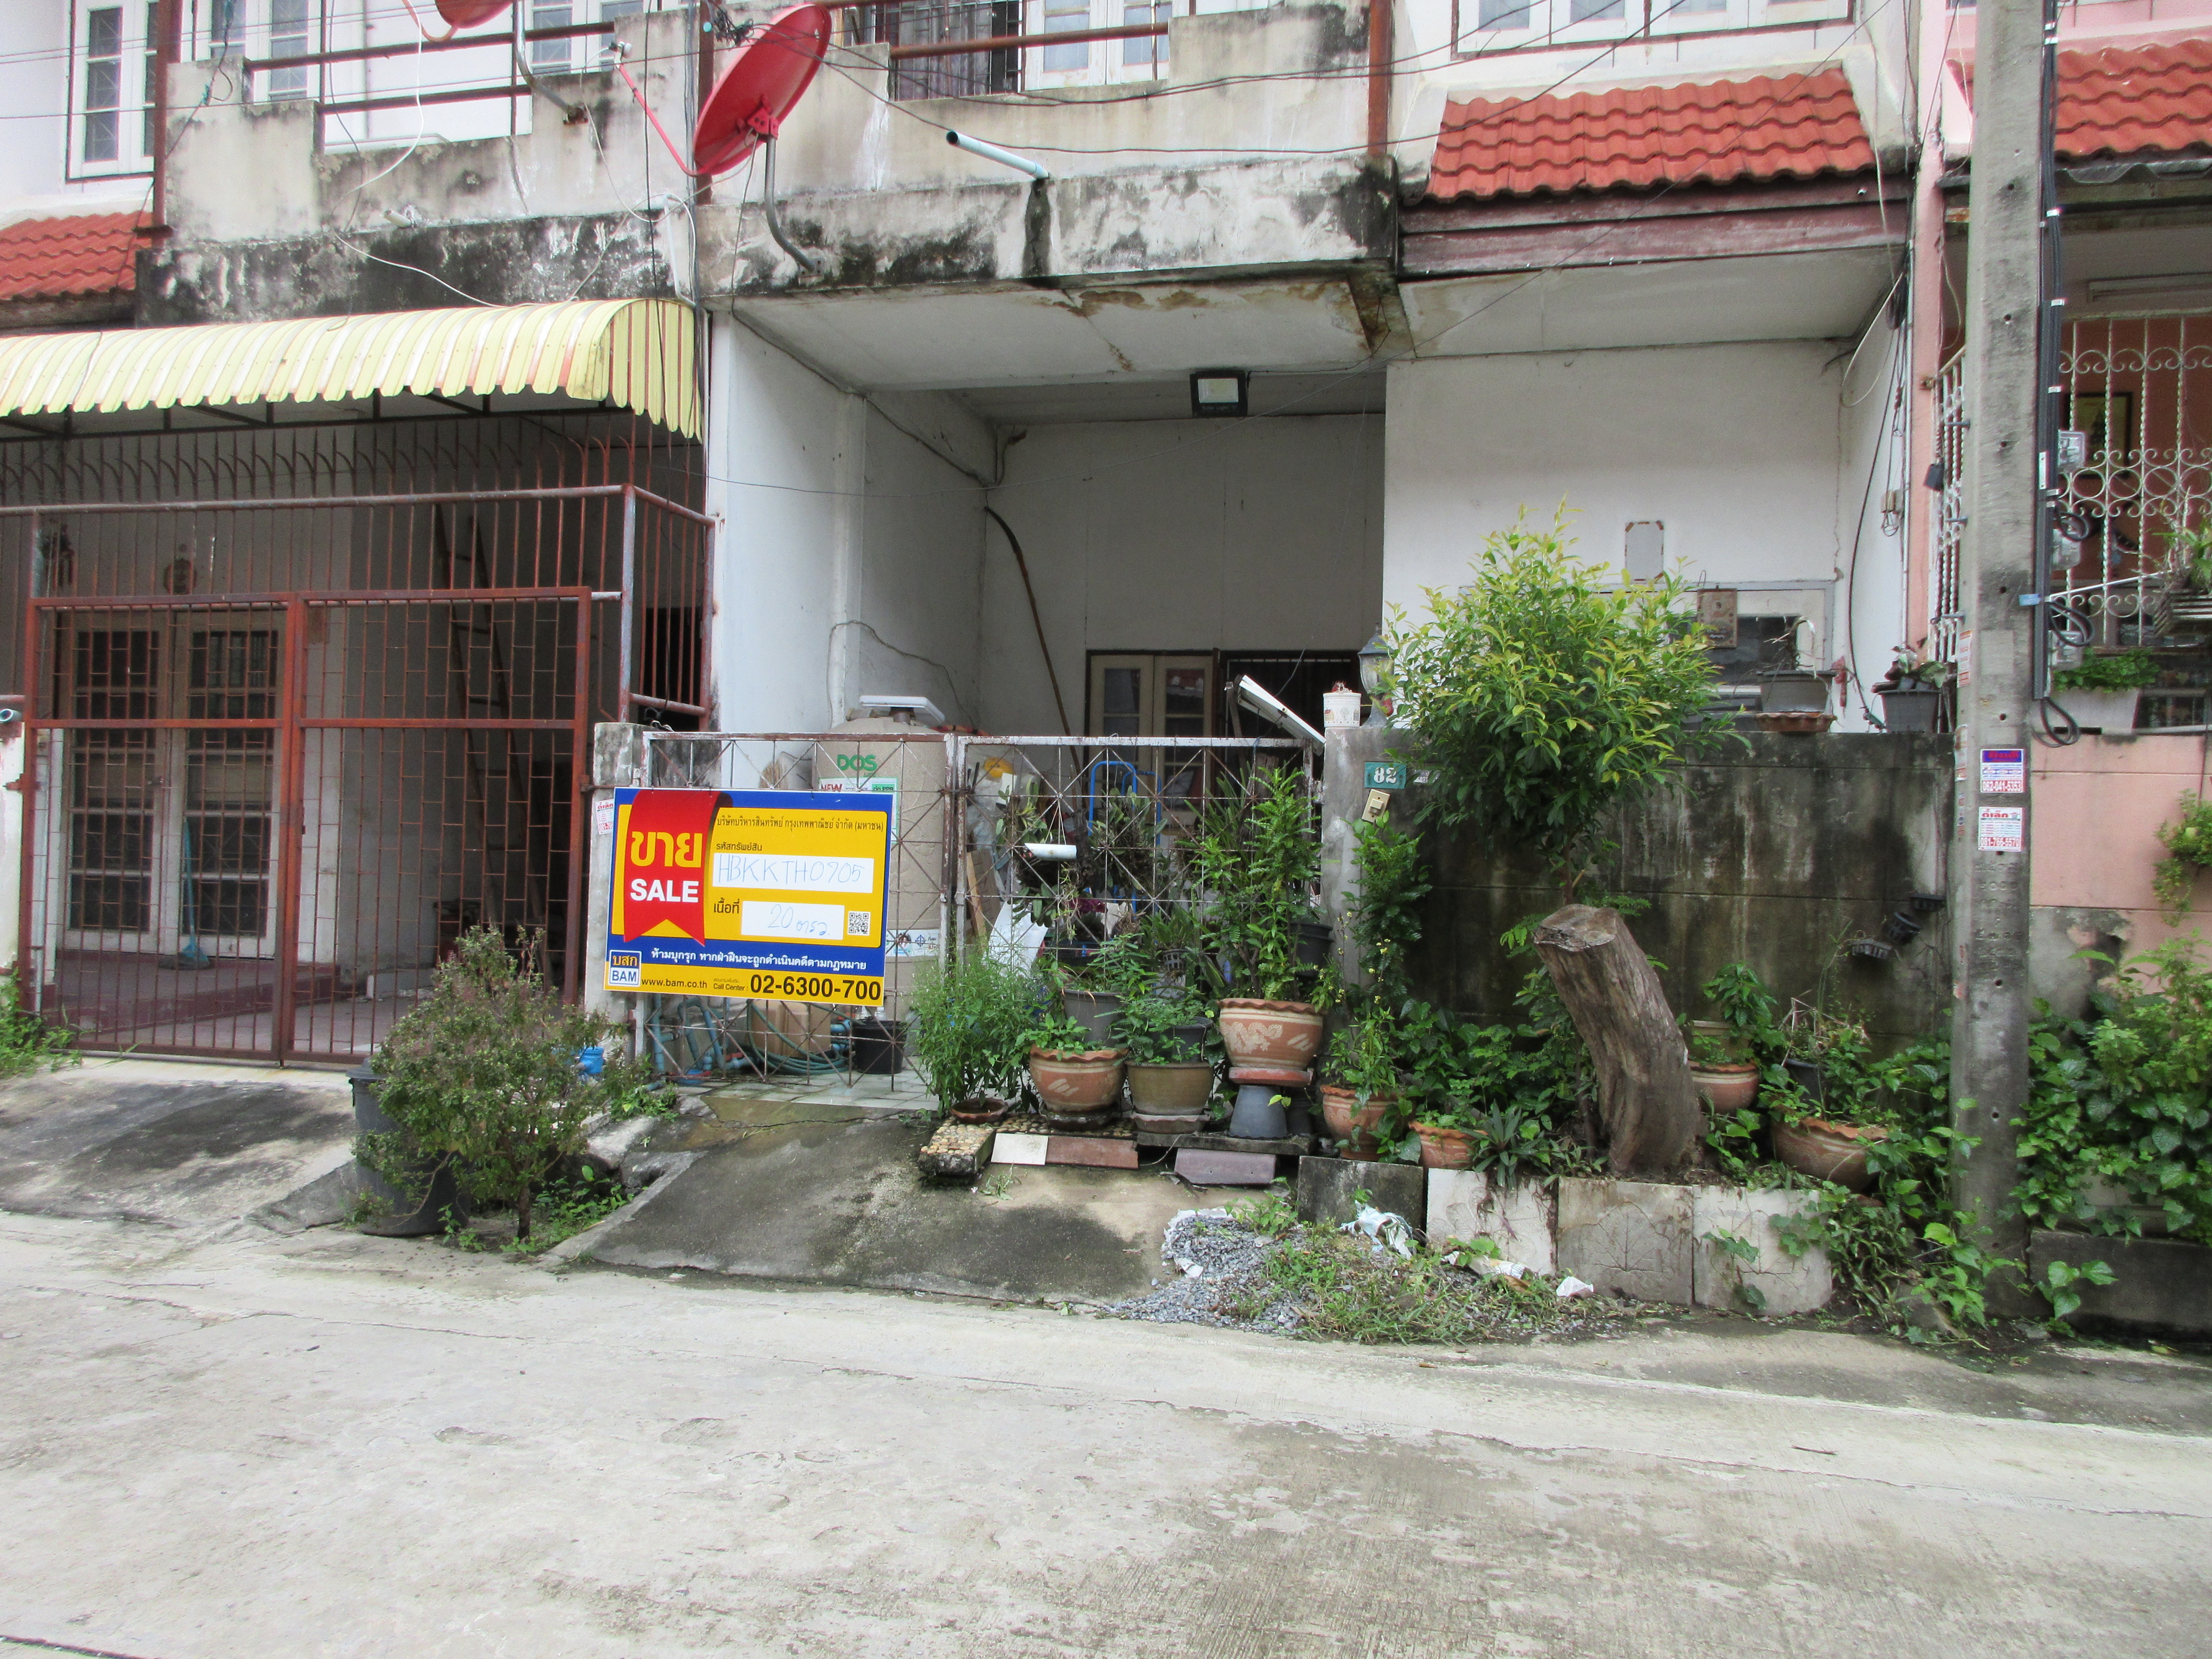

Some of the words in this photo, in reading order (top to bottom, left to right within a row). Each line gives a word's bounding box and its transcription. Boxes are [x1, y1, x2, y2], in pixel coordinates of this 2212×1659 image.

[837, 754, 878, 771] DOS
[1374, 767, 1397, 783] 82
[717, 815, 784, 827] บริษัทบริหารสินทรัพย์
[785, 817, 834, 832] กรุงเทพพาณิชย์
[835, 819, 853, 830] จำกัด
[855, 822, 884, 832] (มหาชน)
[631, 830, 702, 868] ขาย
[716, 842, 763, 851] รหัสทรัพย์สิน
[630, 879, 699, 903] SALE
[713, 897, 739, 914] เนื้อที่
[768, 904, 793, 929] 20
[612, 955, 638, 966] บสก
[651, 948, 696, 963] ห้ามบุกรุก
[700, 952, 867, 971] หากฝ่าฝืนจะถูกดำเนินคดีตามกฎหมาย
[612, 970, 637, 982] BAM
[641, 978, 707, 989] www.bam.co.th
[750, 974, 881, 1001] 02-6300-700
